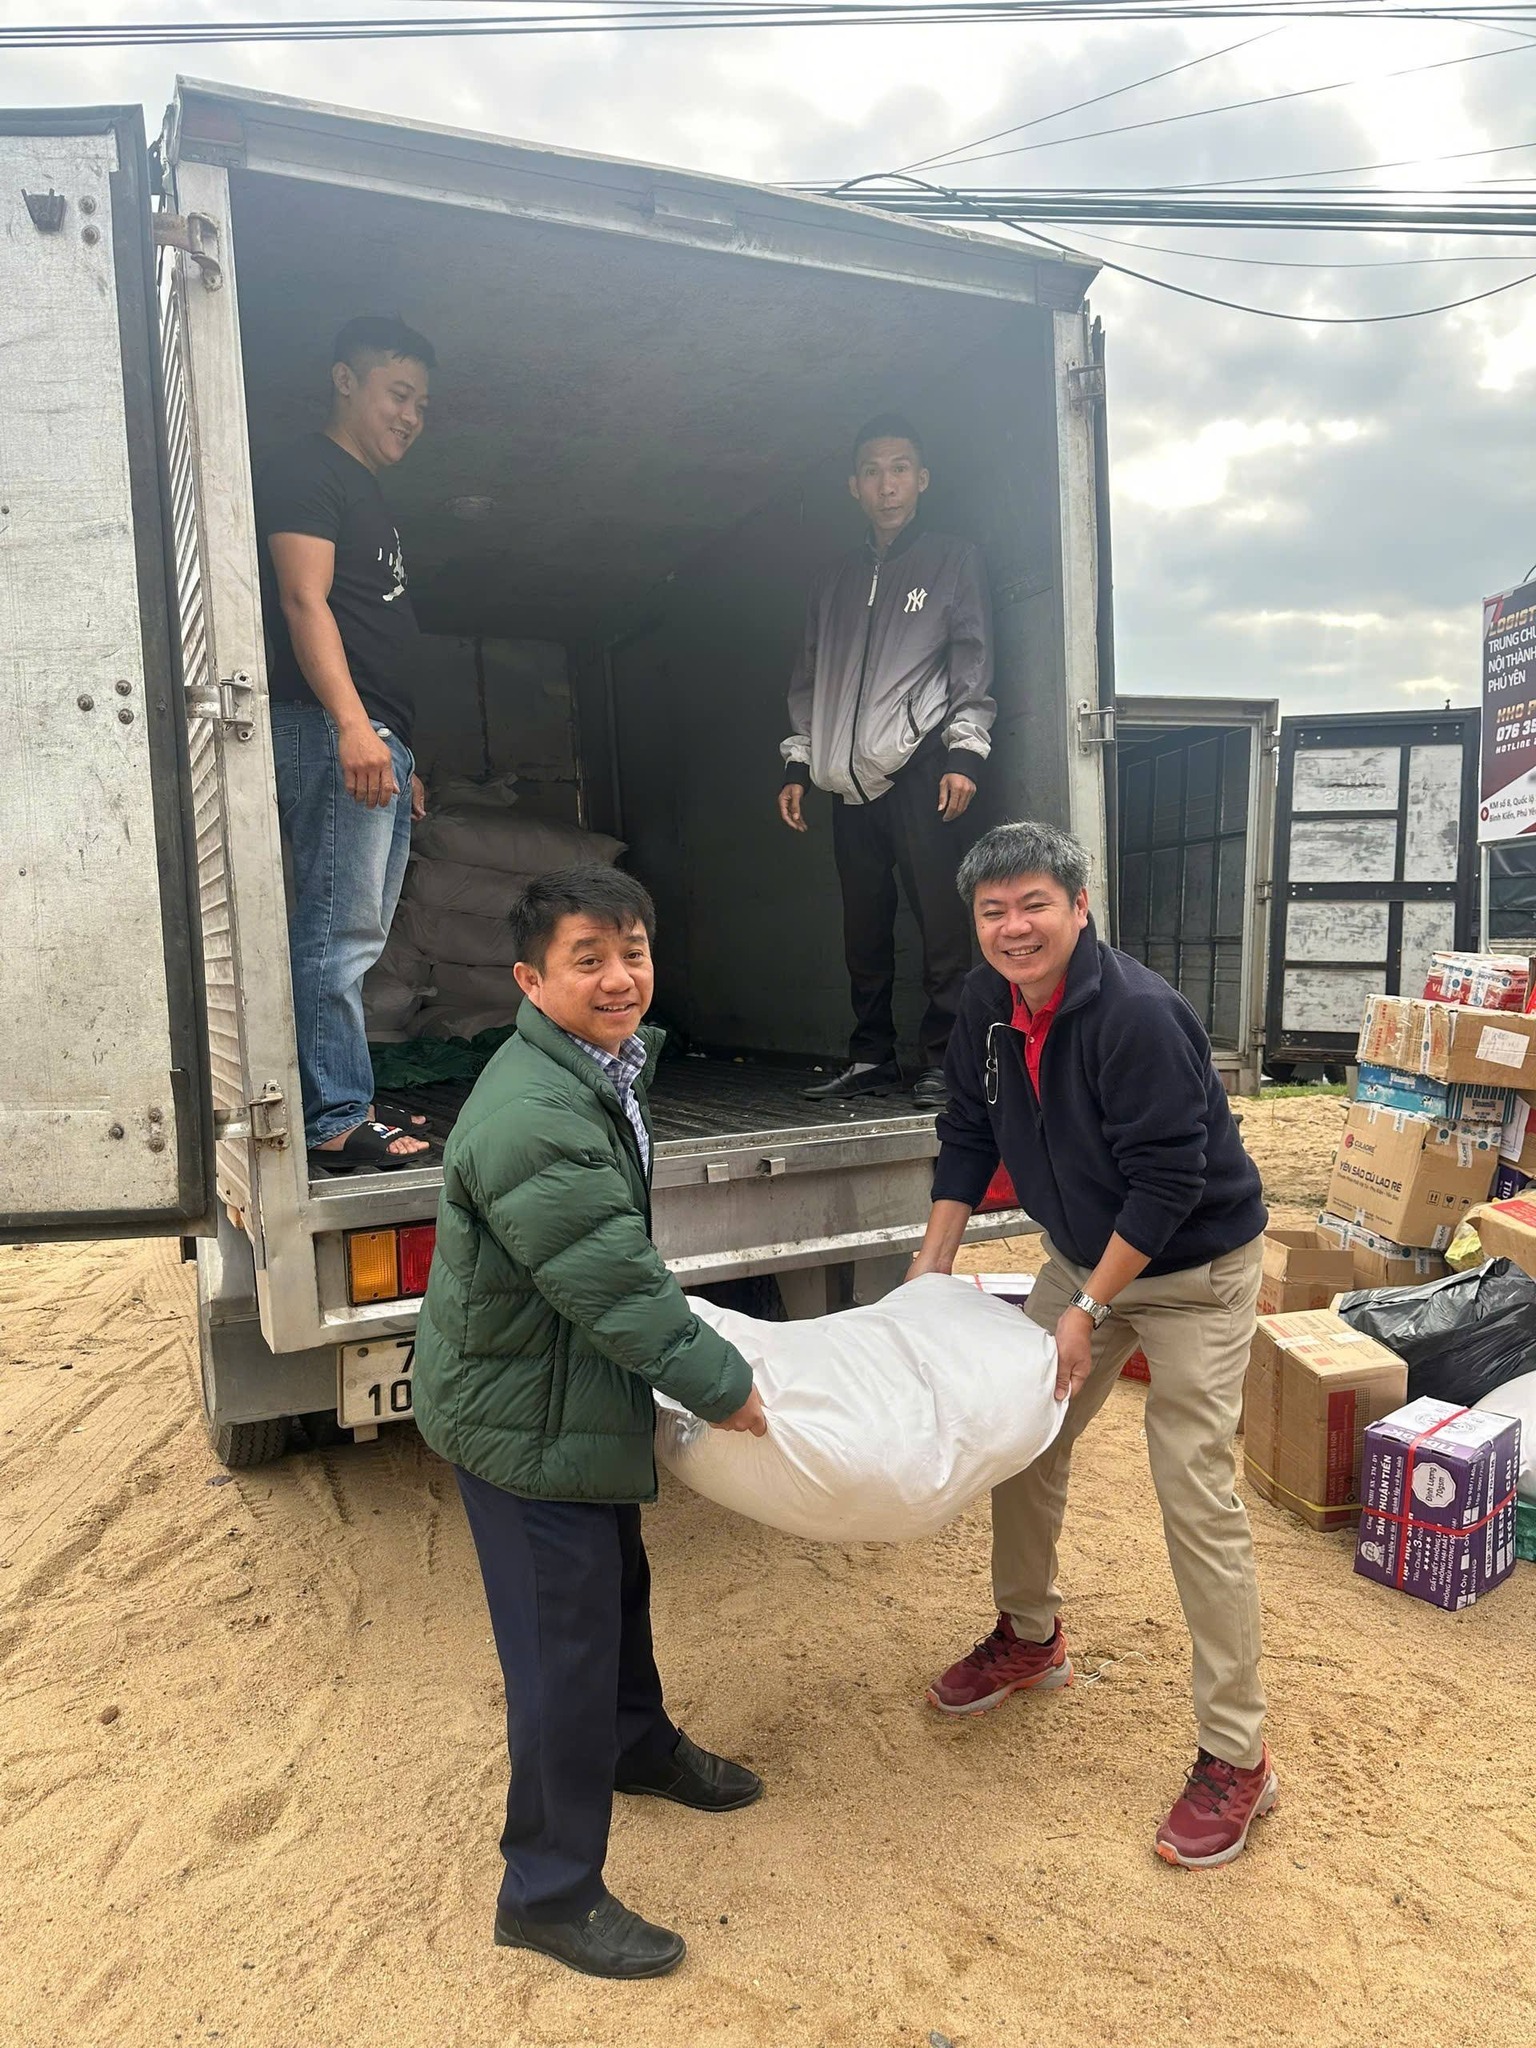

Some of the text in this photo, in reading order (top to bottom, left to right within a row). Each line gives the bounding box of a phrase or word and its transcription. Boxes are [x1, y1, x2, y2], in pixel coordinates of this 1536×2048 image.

[1488, 631, 1520, 653] TRUNG
[1488, 645, 1536, 673] NỘI THÀNH
[1488, 668, 1526, 693] PHÚ YÊN
[1497, 722, 1520, 741] 076
[1496, 739, 1531, 754] HOTLINE
[1376, 1176, 1391, 1188] LAO
[368, 1379, 412, 1416] 10
[1378, 1454, 1392, 1478] TIẾN
[1426, 1466, 1437, 1502] Định Lượng
[1436, 1476, 1445, 1499] 70gsm
[1376, 1516, 1386, 1536] TÂN
[1414, 1540, 1423, 1548] 3
[1432, 1538, 1441, 1562] KHÔNG
[1437, 1563, 1446, 1586] KHÔNG
[1442, 1583, 1452, 1608] KHÔNG
